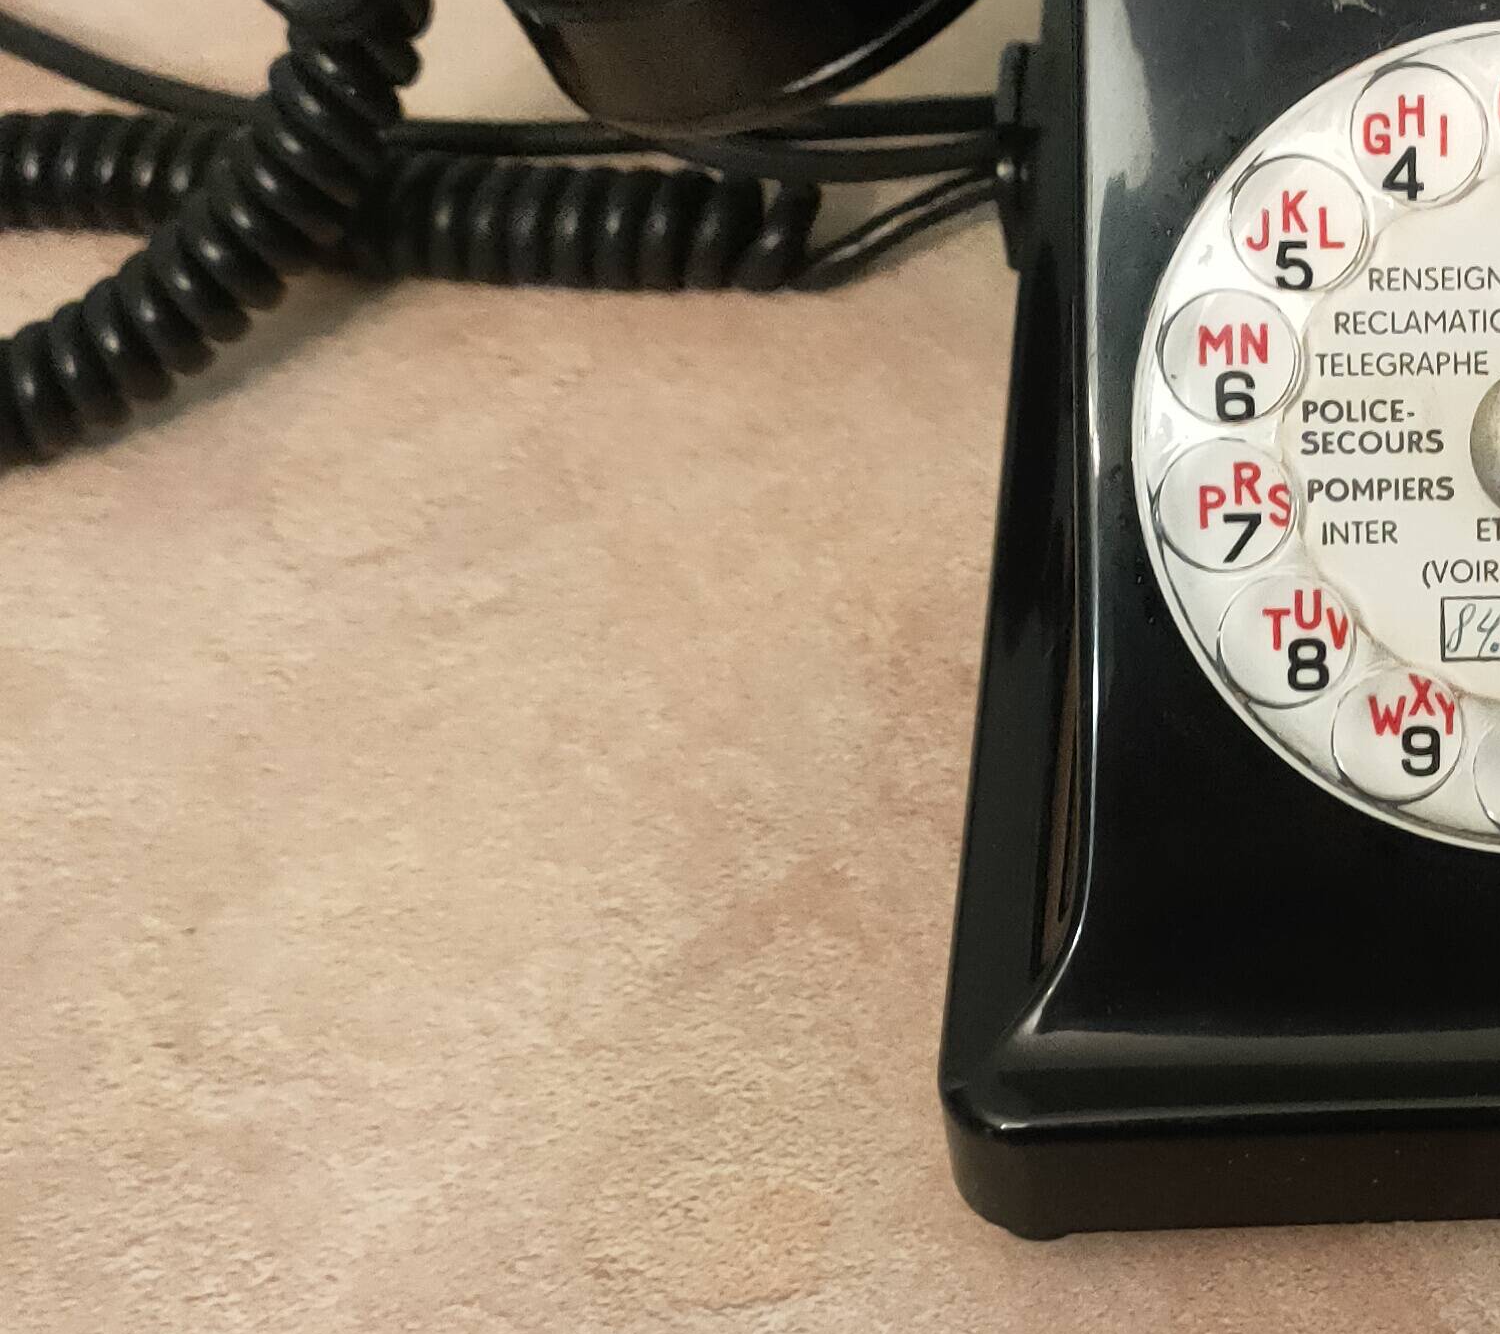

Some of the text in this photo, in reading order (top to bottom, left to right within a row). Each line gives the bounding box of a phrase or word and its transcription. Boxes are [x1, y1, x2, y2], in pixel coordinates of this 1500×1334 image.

[1363, 95, 1448, 157] GHI
[1382, 146, 1424, 201] 4
[1246, 190, 1345, 251] JKL
[1275, 240, 1314, 290] 5
[1198, 323, 1268, 366] MN
[1315, 350, 1489, 377] TELEGRAPHE
[1215, 370, 1256, 422] 6
[1301, 399, 1415, 424] POLICE-
[1301, 429, 1444, 456] SECOURS
[1199, 461, 1291, 530] PRS
[1307, 476, 1455, 503] POMPIERS
[1223, 513, 1262, 563] 7
[1321, 520, 1398, 545] INTER
[1421, 558, 1500, 589] (VOIR
[1262, 589, 1348, 650] TUV
[1287, 637, 1330, 692] 8
[1368, 673, 1455, 736] WXY
[1401, 725, 1441, 777] 9
